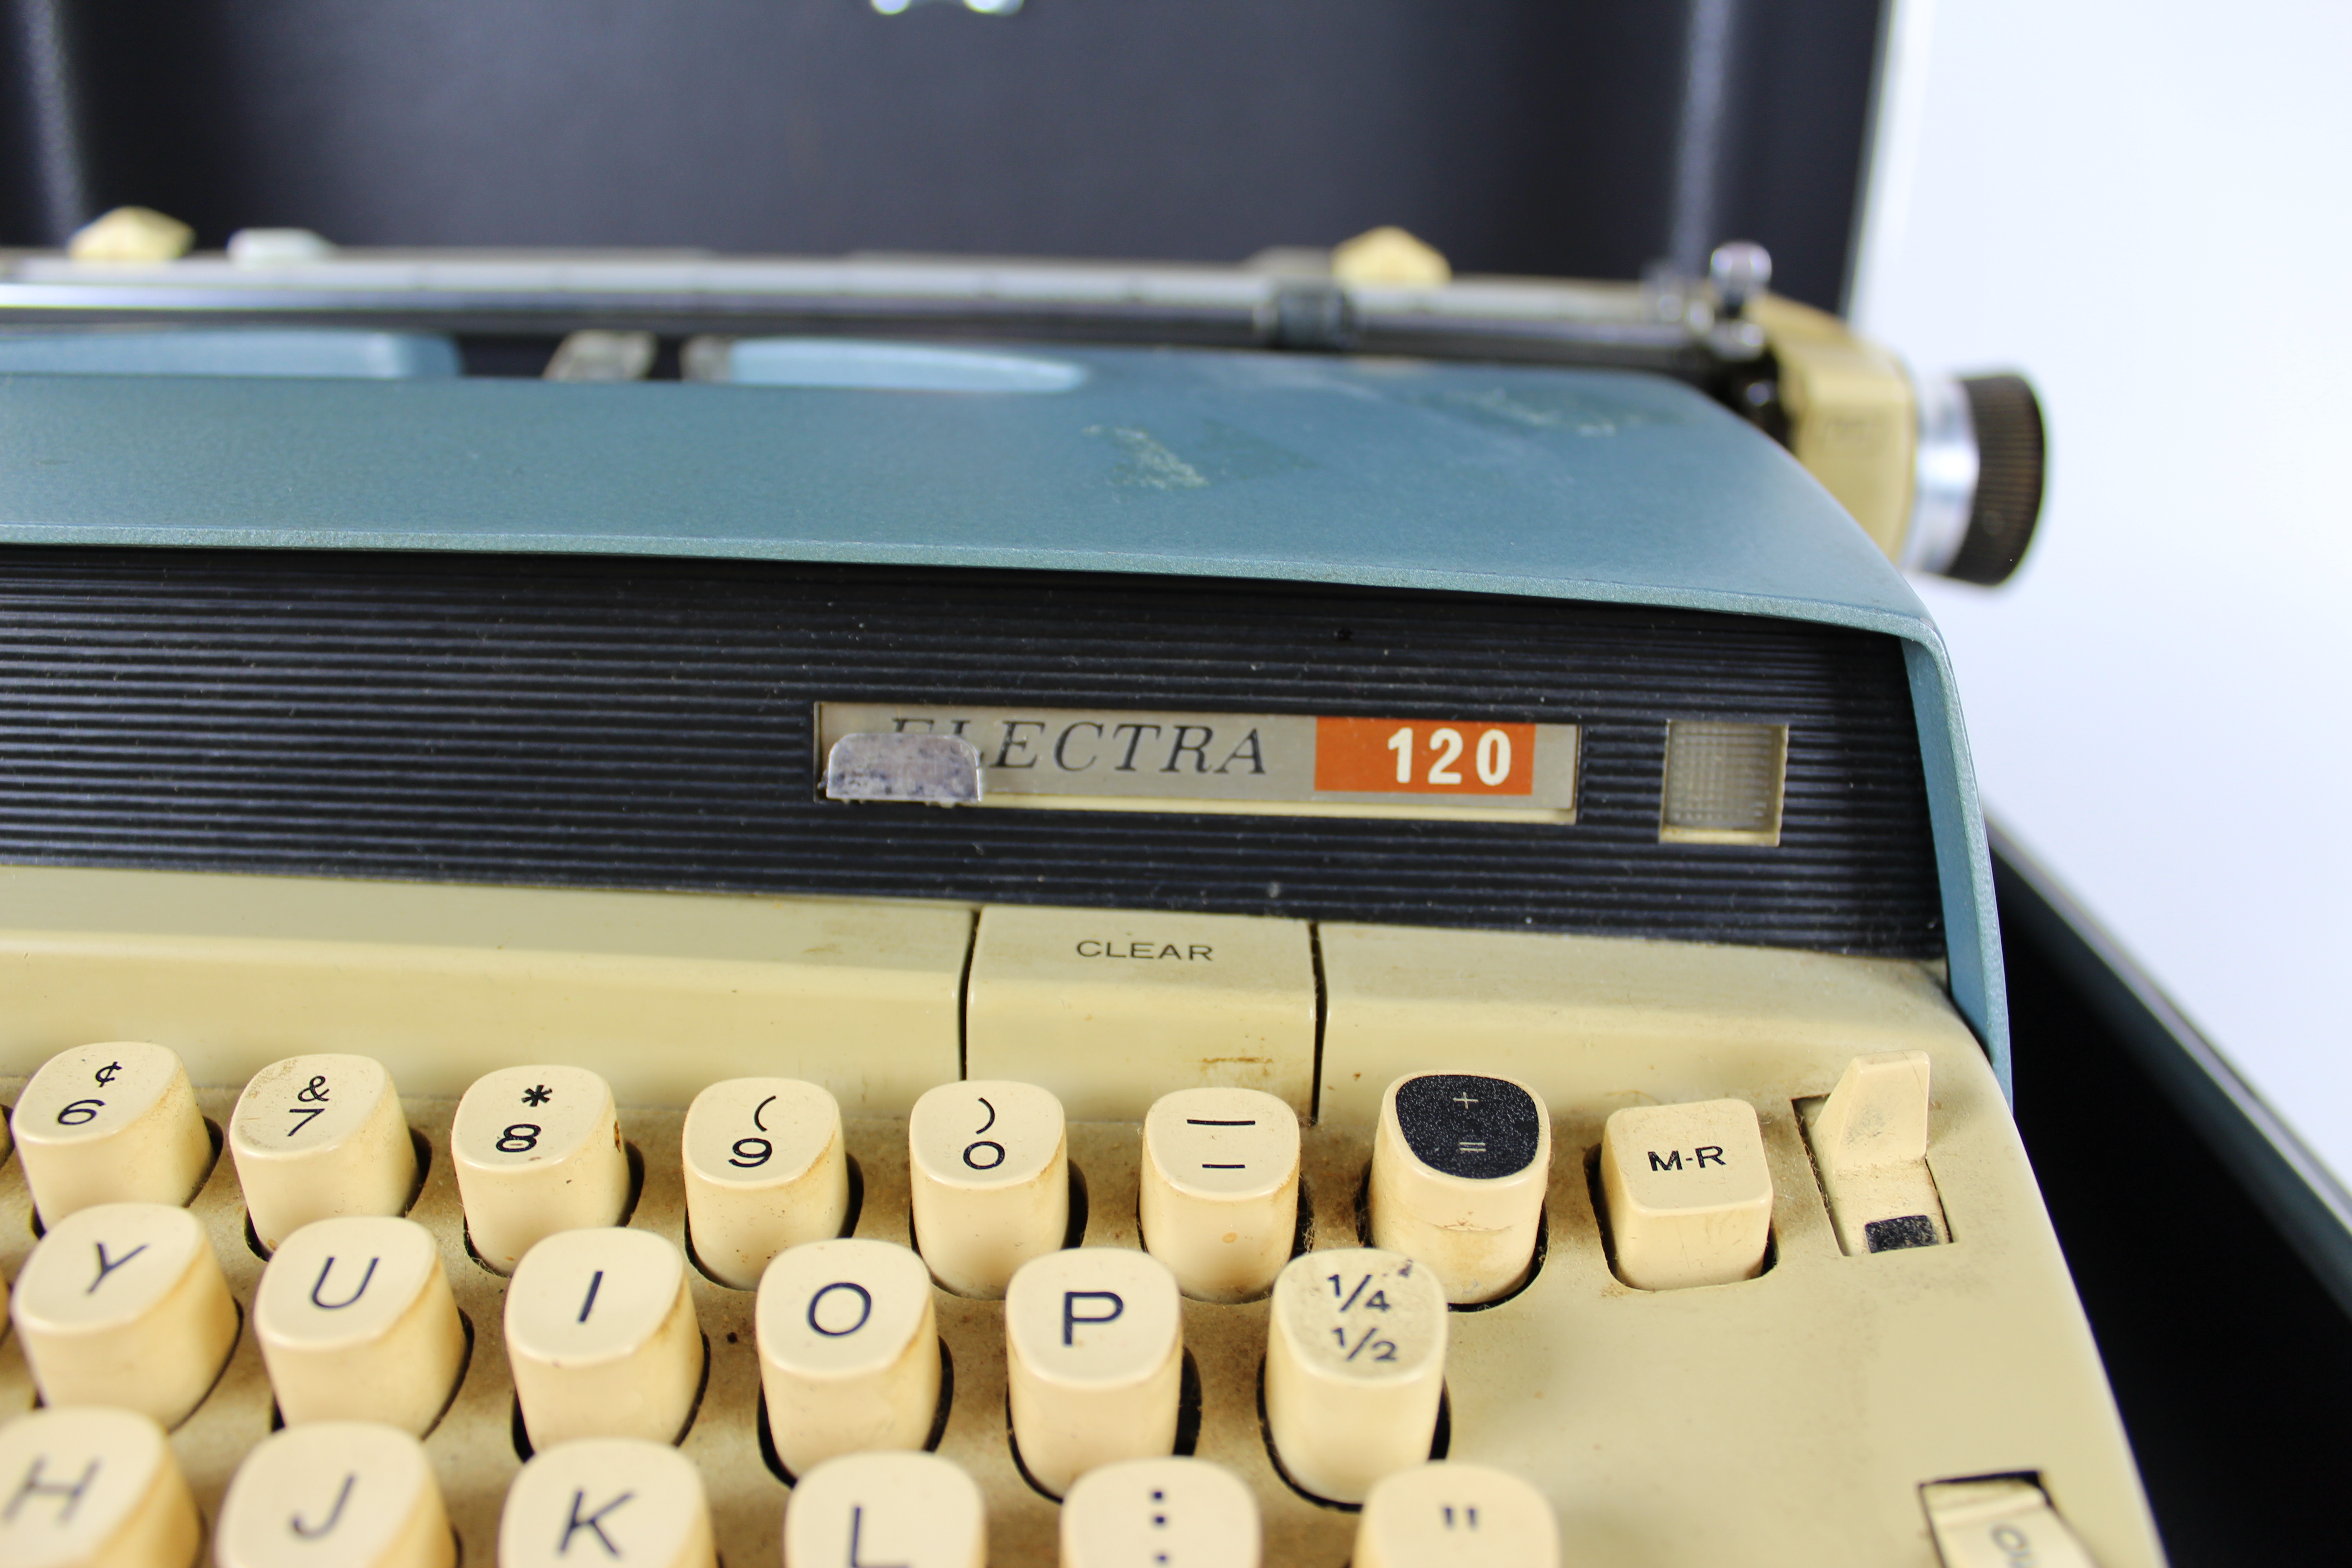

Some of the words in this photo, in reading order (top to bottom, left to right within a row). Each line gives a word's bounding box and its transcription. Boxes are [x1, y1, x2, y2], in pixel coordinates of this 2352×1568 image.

[892, 718, 1269, 775] ECTRA
[1388, 728, 1511, 785] 120
[1077, 941, 1212, 960] CLEAR
[95, 1062, 122, 1087] ¢
[298, 1076, 329, 1102] &
[58, 1100, 104, 1125] 6
[755, 1096, 776, 1132] (
[976, 1098, 995, 1134] )
[1453, 1092, 1478, 1109] +
[288, 1109, 324, 1136] 7
[496, 1124, 541, 1152] 8
[729, 1138, 772, 1167] 9
[1459, 1141, 1486, 1153] =
[1648, 1147, 1725, 1171] M-R
[86, 1242, 150, 1295] Y
[312, 1257, 378, 1308] U
[808, 1283, 871, 1336] O
[1328, 1274, 1391, 1312] 1/4
[1064, 1292, 1123, 1345] P
[1332, 1327, 1397, 1362] 1/2
[1, 1455, 102, 1524] H
[289, 1473, 358, 1541] J
[557, 1489, 636, 1557] K
[848, 1506, 913, 1568] L
